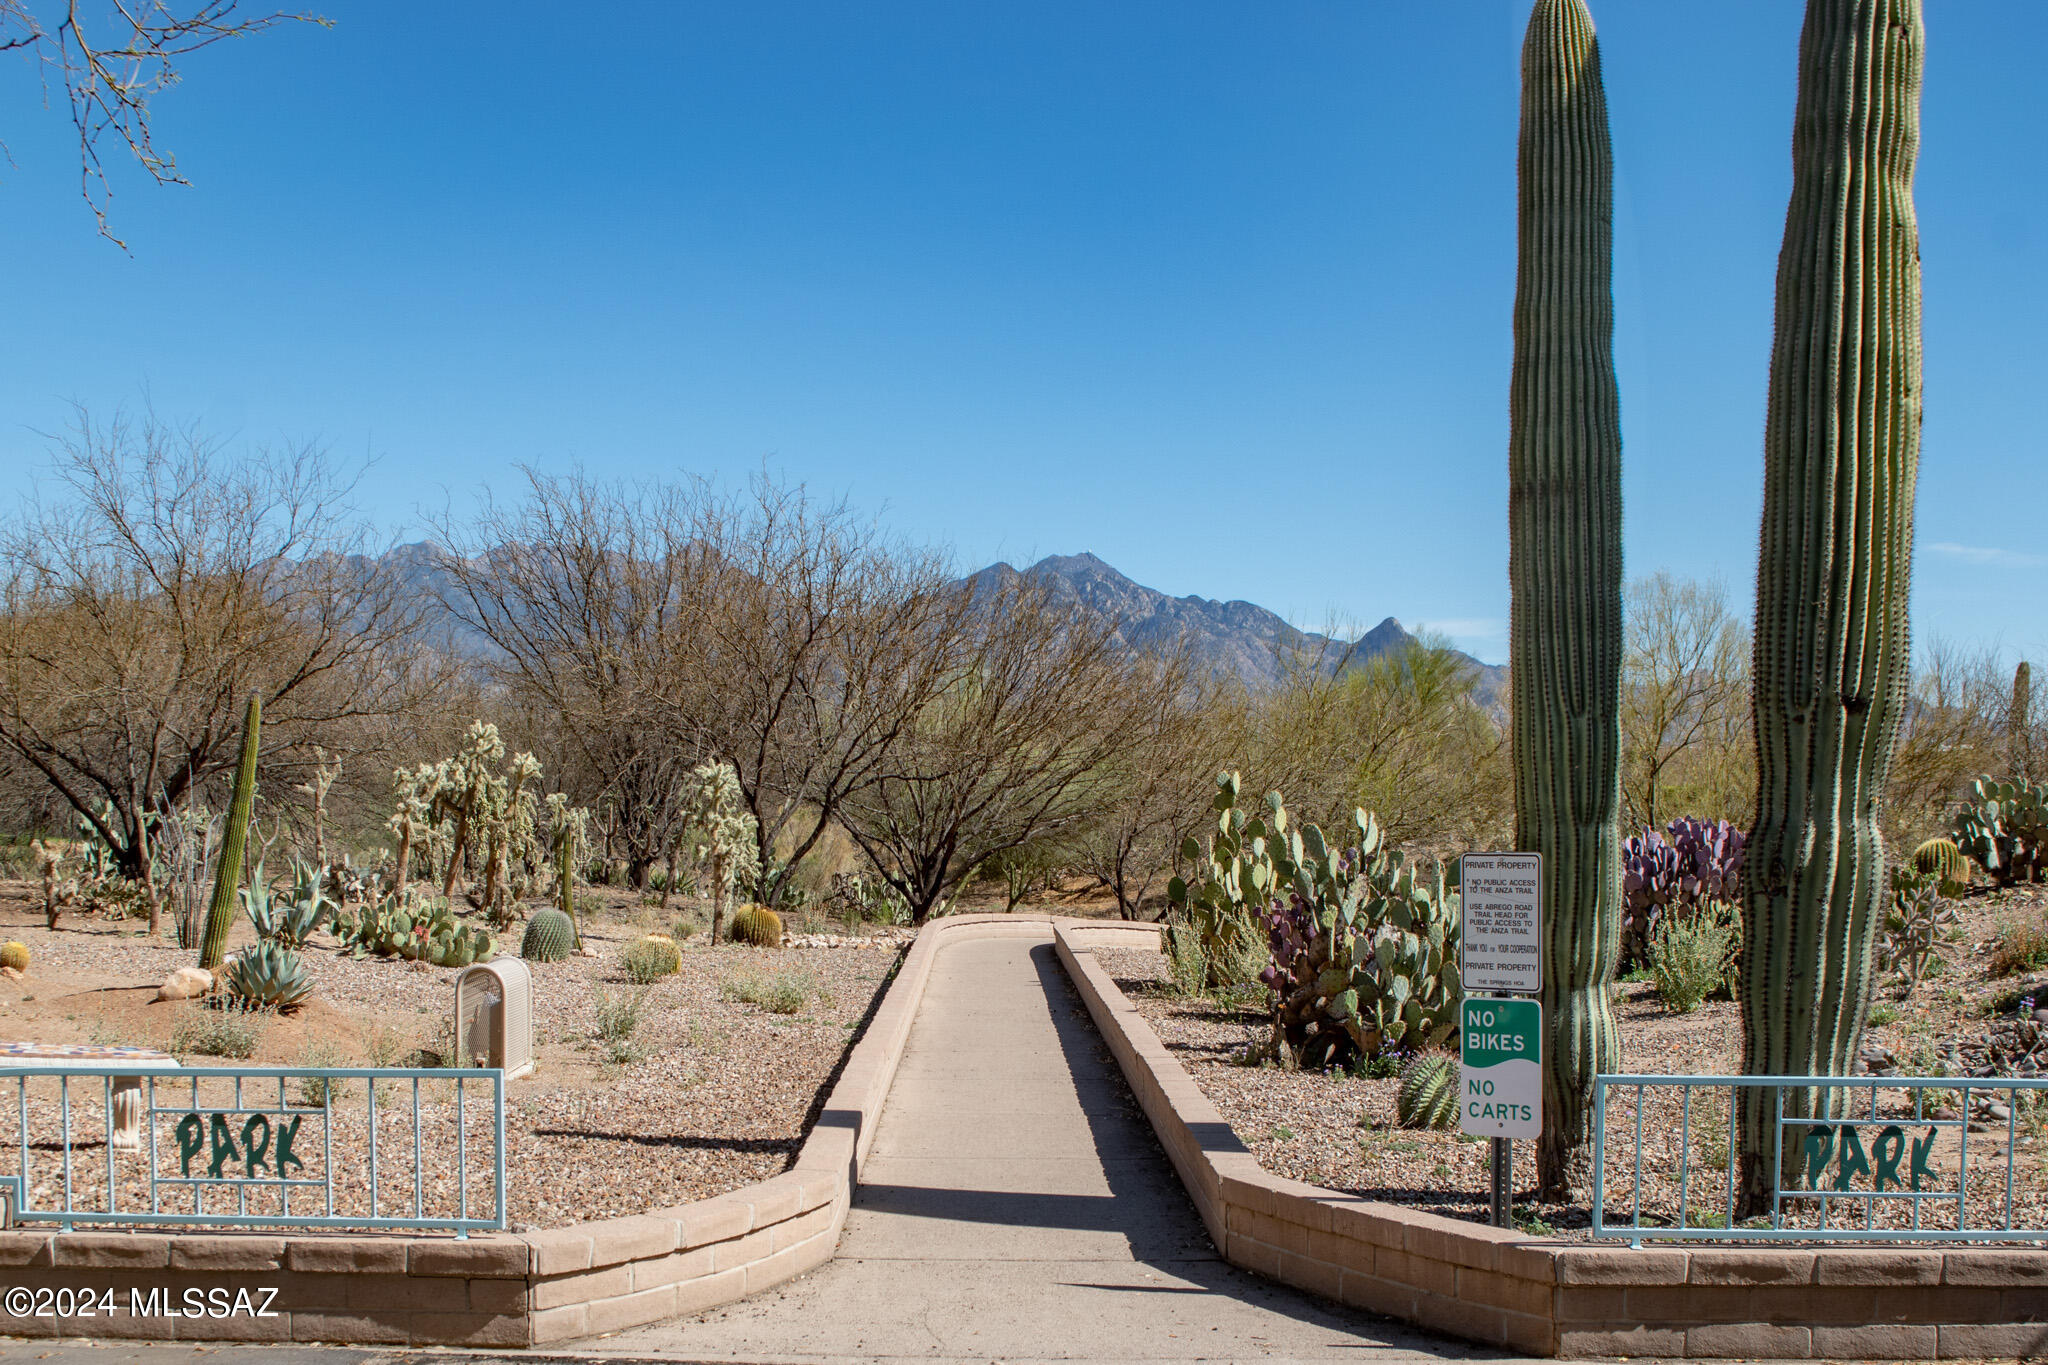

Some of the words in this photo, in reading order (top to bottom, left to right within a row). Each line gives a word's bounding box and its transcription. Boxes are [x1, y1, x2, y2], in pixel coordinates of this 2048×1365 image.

[1465, 861, 1494, 869] PRIVATE
[1497, 861, 1537, 870] PROPERTY
[1509, 879, 1536, 887] ACCESS
[1469, 886, 1478, 894] TO
[1480, 886, 1493, 894] THE
[1495, 886, 1513, 894] ANZA
[1485, 903, 1512, 911] ABREGO
[1515, 911, 1528, 919] FOR
[1494, 919, 1522, 927] ACCESS
[1476, 926, 1488, 934] THE
[1511, 927, 1529, 935] TRAIL
[1465, 943, 1478, 952] THANK
[1479, 943, 1488, 953] YOU
[1498, 944, 1509, 953] YOUR
[1510, 944, 1538, 954] COOPERATION
[1465, 962, 1494, 970] PRIVATE
[1497, 963, 1536, 972] PROPERTY
[1468, 1010, 1495, 1028] NO
[1468, 1032, 1525, 1051] BIKES
[1468, 1079, 1495, 1096] NO
[1468, 1101, 1532, 1121] CARTS
[176, 1113, 305, 1179] PARK
[1804, 1125, 1940, 1192] PARK
